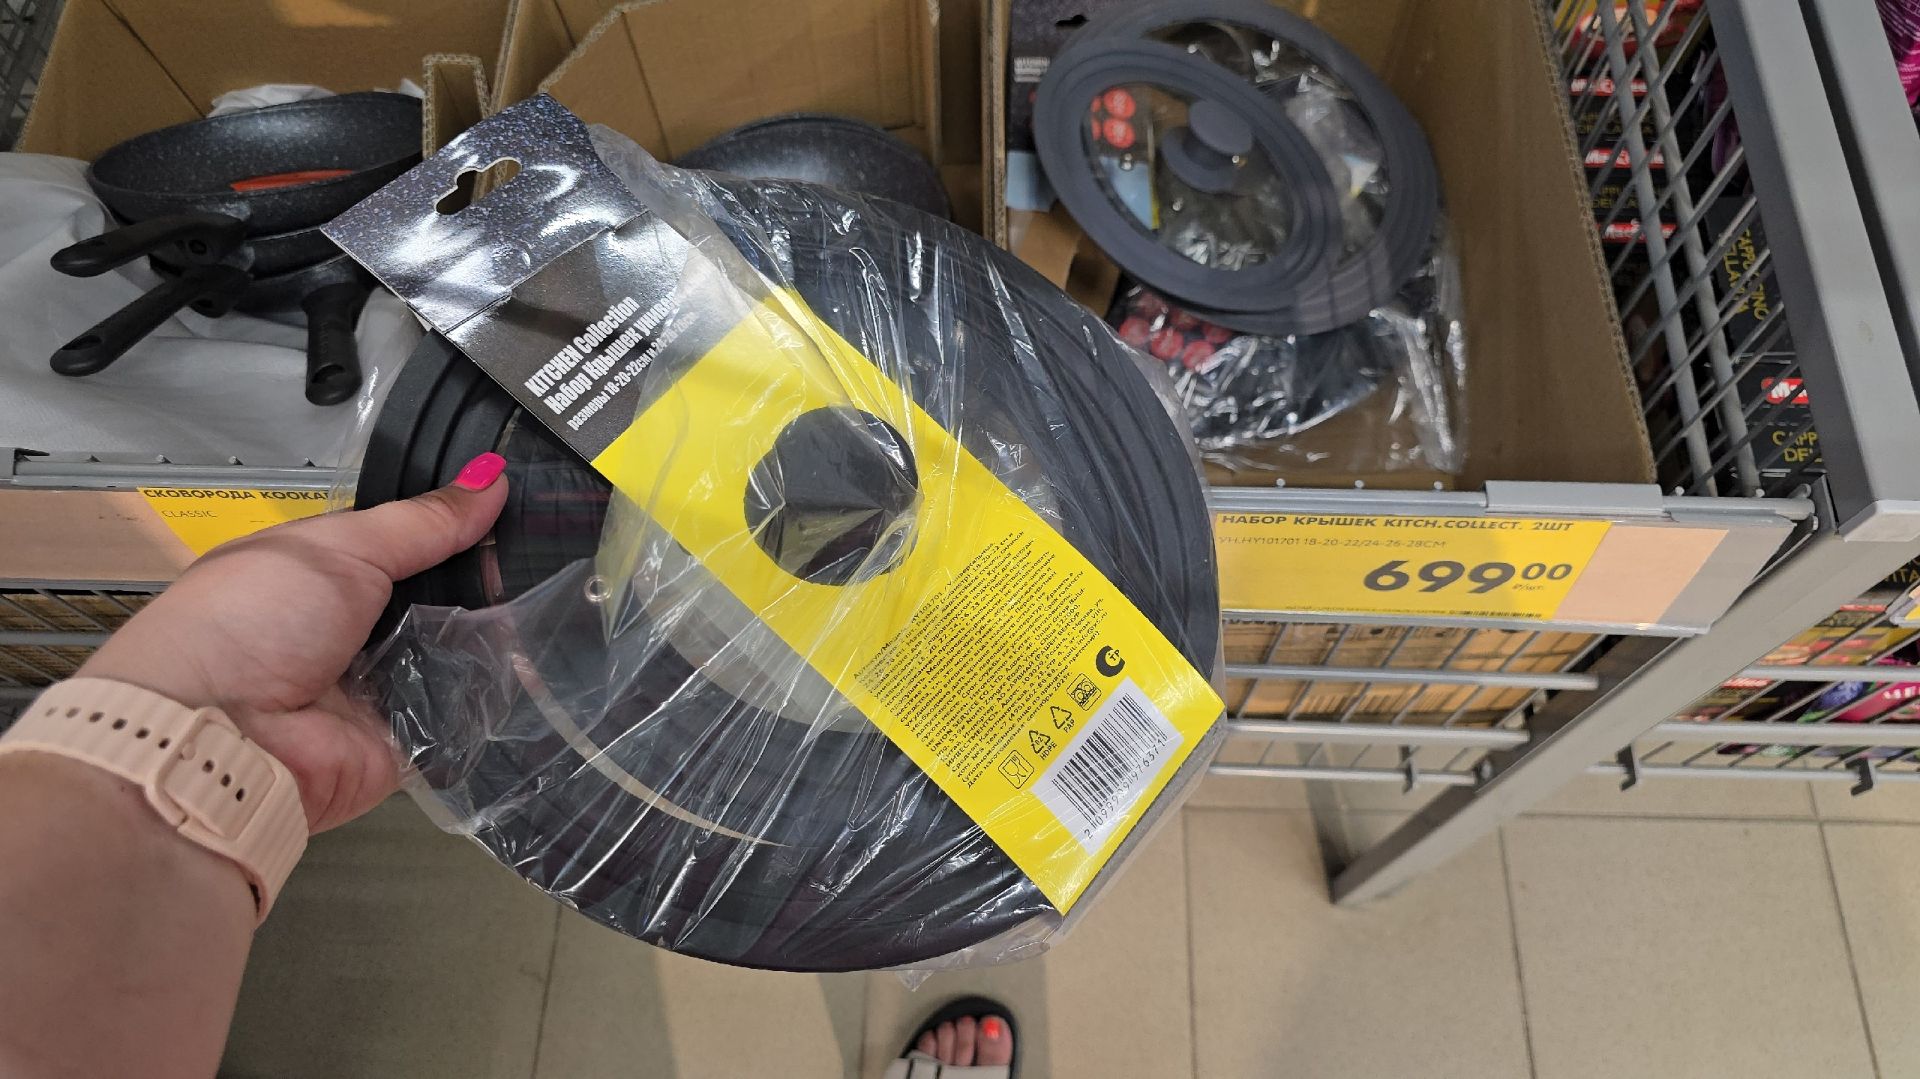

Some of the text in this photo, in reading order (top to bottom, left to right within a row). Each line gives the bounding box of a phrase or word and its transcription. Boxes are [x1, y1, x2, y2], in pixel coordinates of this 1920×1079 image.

[524, 293, 640, 397] KITCHEN Collection
[542, 368, 594, 415] Набор
[581, 324, 643, 381] Крышек
[566, 389, 611, 430] размеры
[143, 489, 256, 500] СКОВОРОДА
[161, 510, 217, 518] CLASSIC
[1221, 515, 1573, 532] НАБОР КРЫШЕК KITCH.COLLECT. 2ШТ
[1363, 560, 1573, 594] 699 00
[1063, 718, 1076, 733] PAP
[1039, 741, 1057, 760] HDPE
